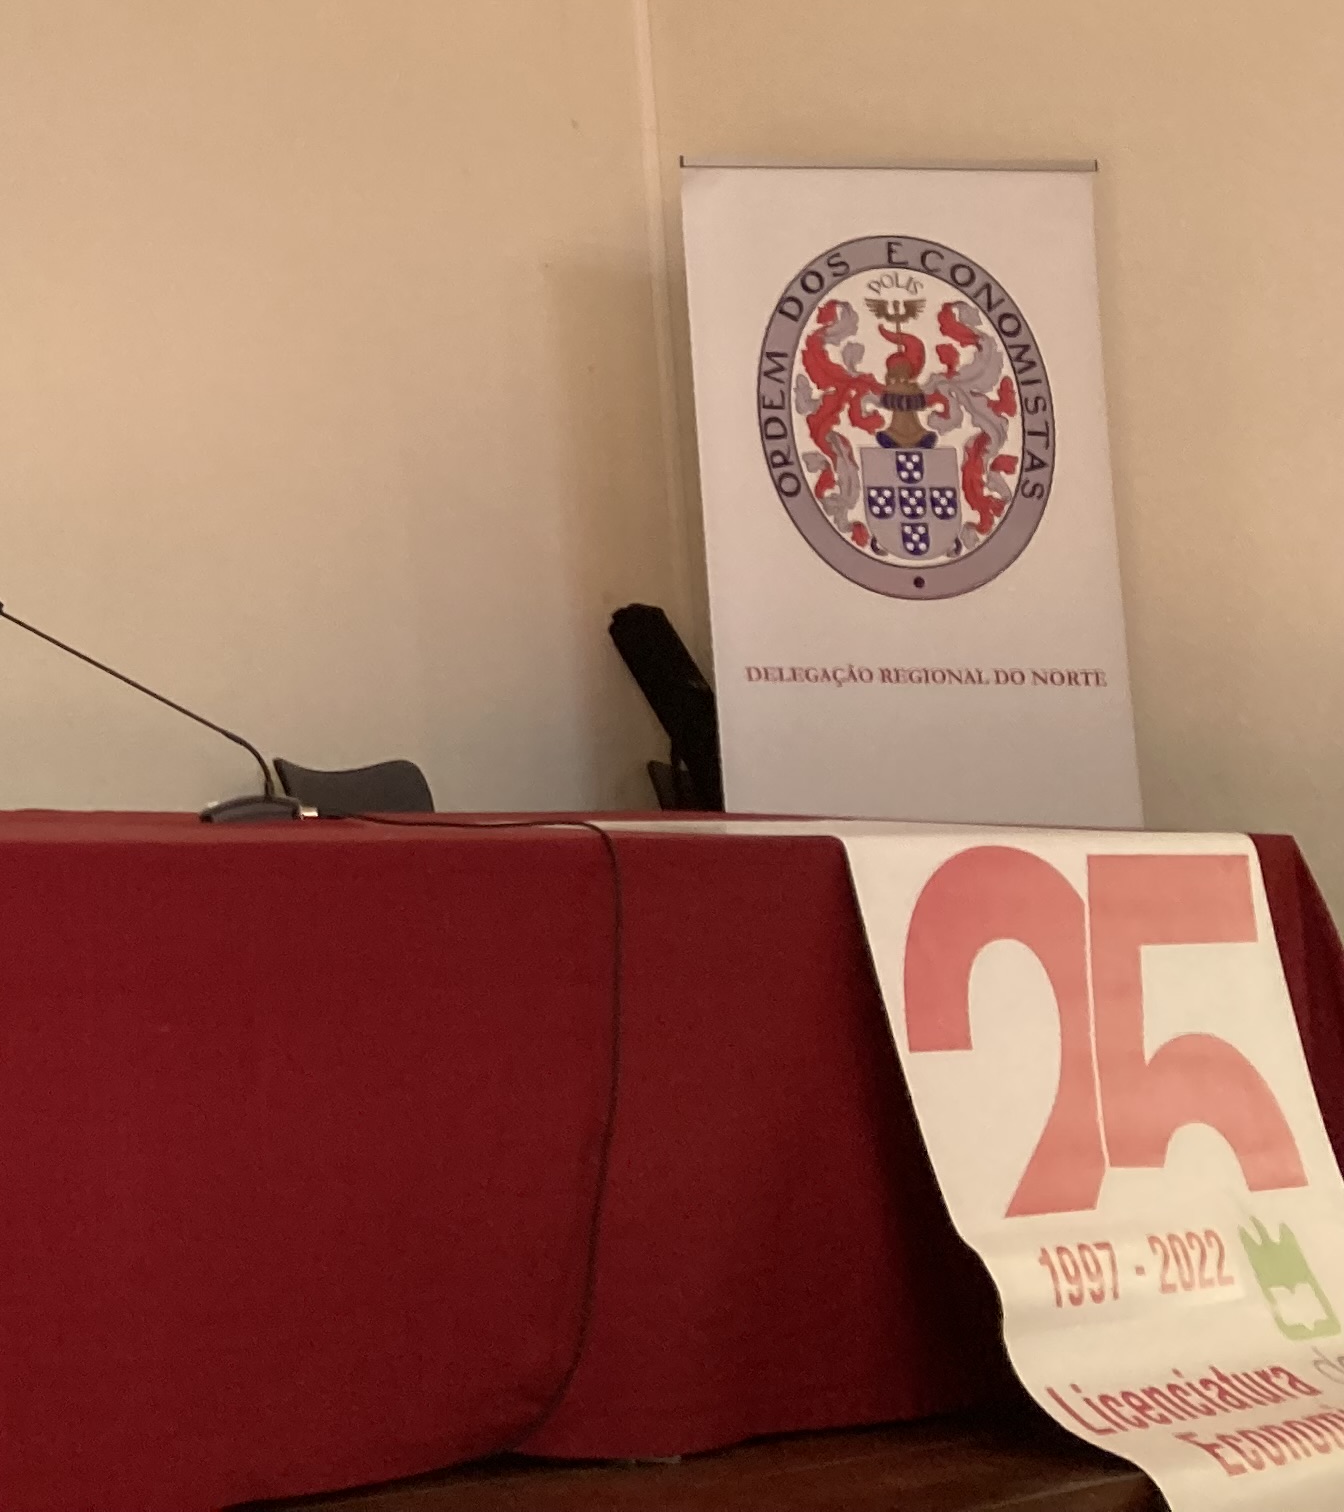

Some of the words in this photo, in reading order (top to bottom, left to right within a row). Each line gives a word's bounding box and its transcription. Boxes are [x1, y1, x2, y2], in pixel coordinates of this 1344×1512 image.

[776, 253, 851, 324] DOS
[886, 240, 1051, 501] ECONOMISTAS
[762, 350, 802, 498] ORDEM
[744, 664, 874, 687] DELEGAÇÃO
[879, 668, 990, 686] REGIONAL
[994, 669, 1026, 686] DO
[1031, 668, 1108, 687] NORTE
[904, 845, 1309, 1218] 25
[1039, 1240, 1119, 1308] 1997
[1135, 1264, 1145, 1277] -
[1149, 1228, 1235, 1295] 2022
[1047, 1364, 1323, 1436] Licenciatura
